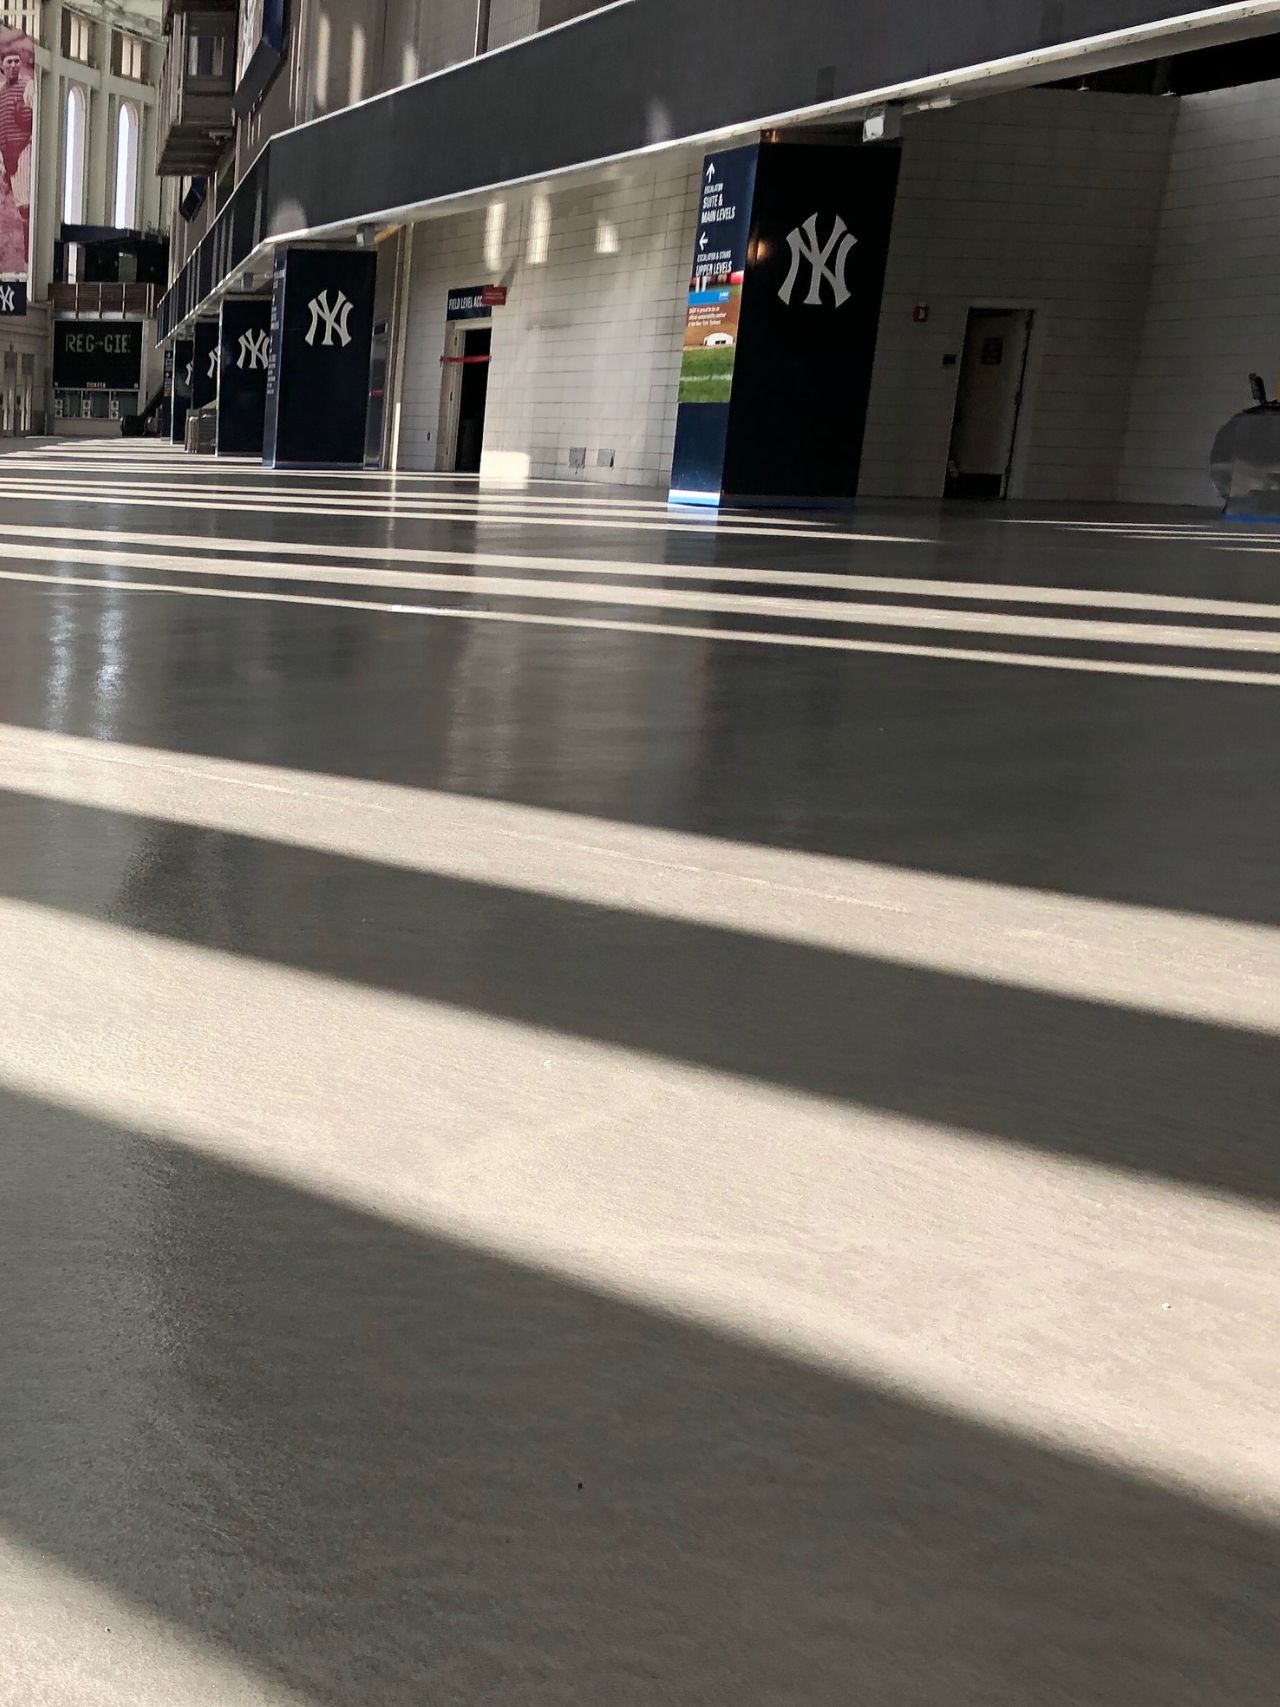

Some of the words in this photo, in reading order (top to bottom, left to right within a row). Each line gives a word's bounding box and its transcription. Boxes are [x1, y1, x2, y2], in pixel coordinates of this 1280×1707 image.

[703, 194, 718, 209] SUITE
[718, 193, 723, 206] &
[701, 210, 716, 223] MAIN
[717, 206, 735, 221] LEVELS
[778, 211, 858, 308] NY
[695, 263, 713, 277] UPPER
[713, 260, 732, 275] LEVELS
[449, 297, 460, 310] FIELD
[460, 296, 473, 309] LEVEL
[473, 295, 485, 307] ACC
[305, 289, 354, 348] NY
[236, 328, 270, 369] NY
